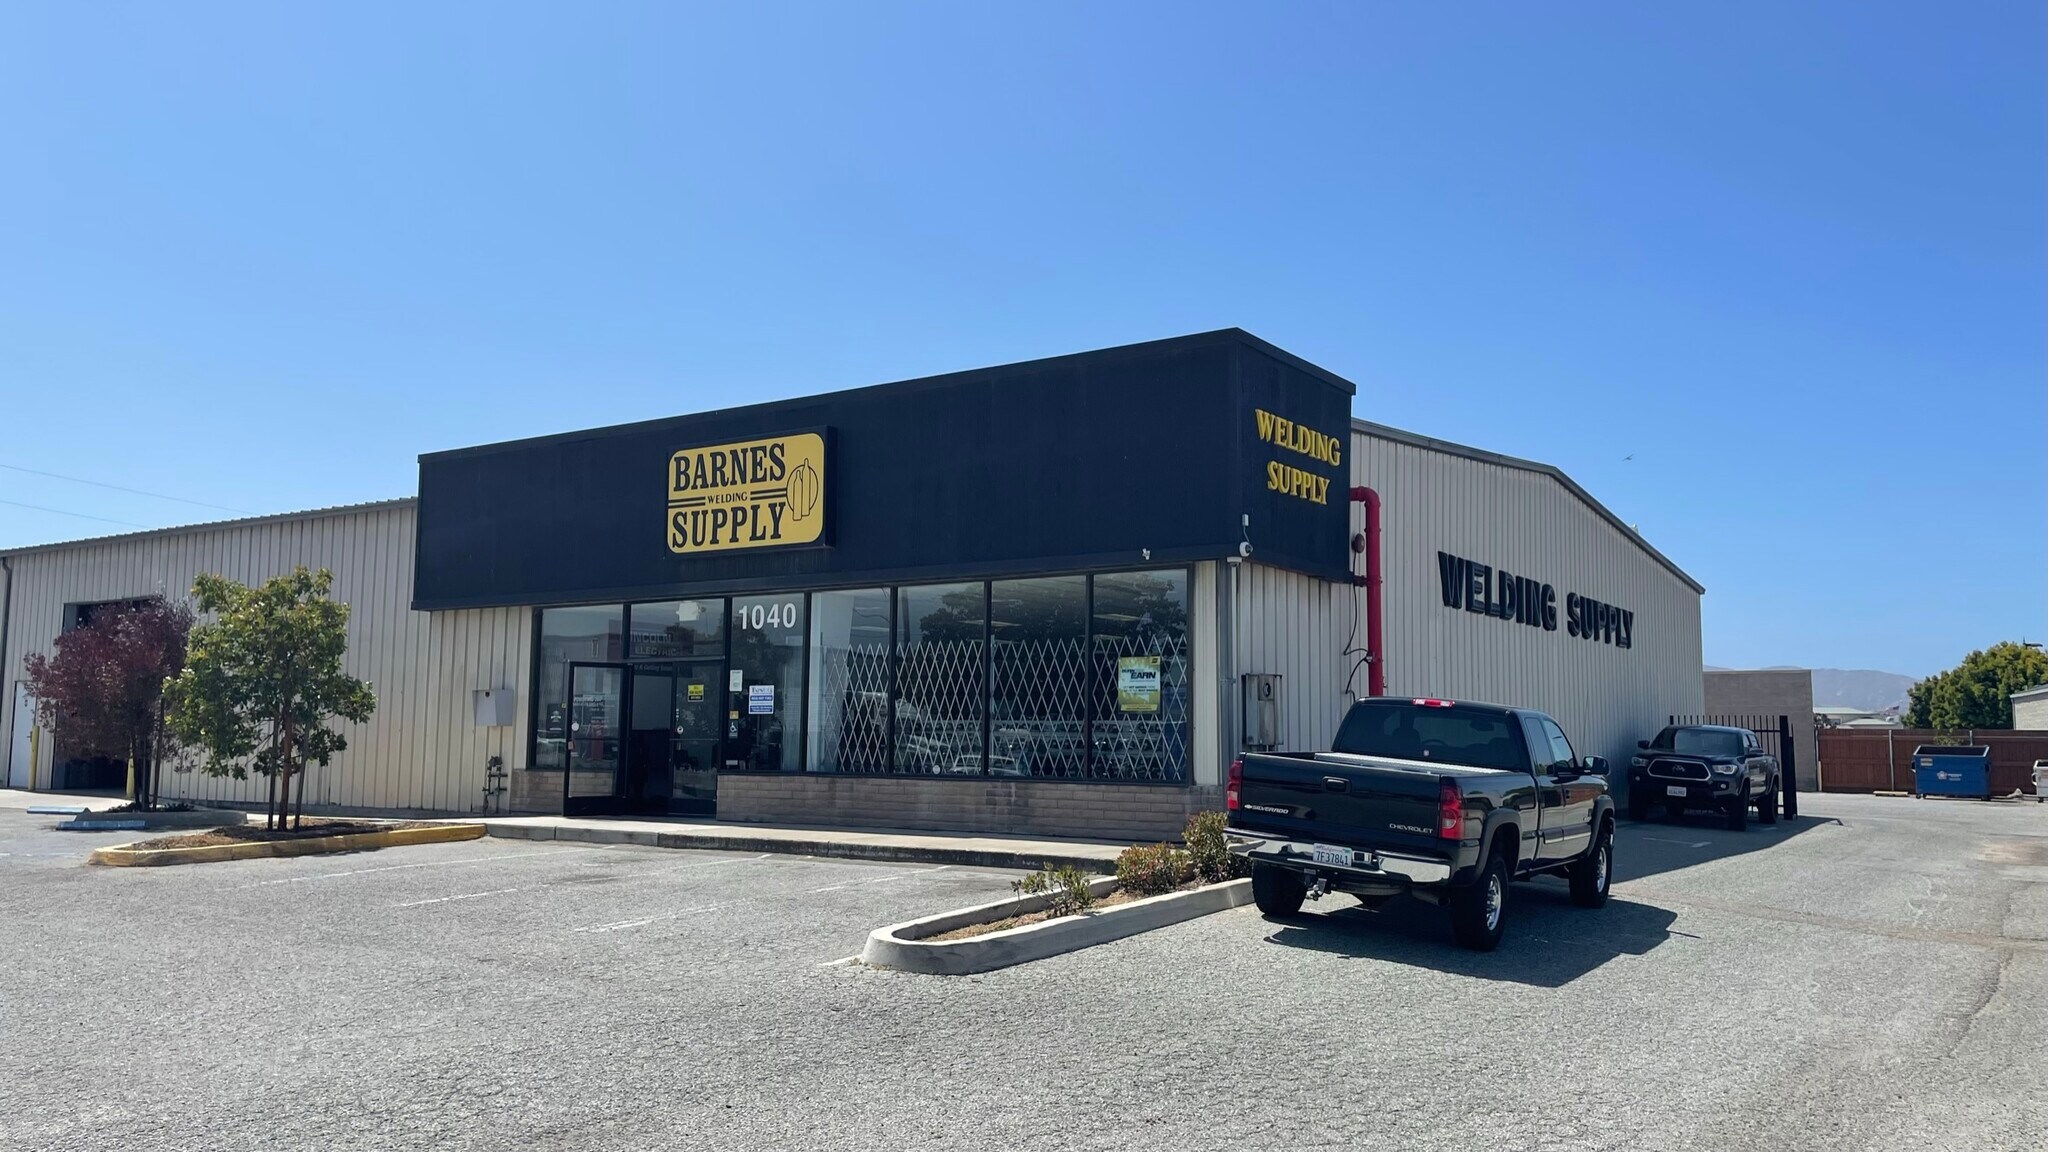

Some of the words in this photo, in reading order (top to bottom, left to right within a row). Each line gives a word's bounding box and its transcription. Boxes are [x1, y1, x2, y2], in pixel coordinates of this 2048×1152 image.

[1255, 408, 1341, 467] WELDING
[673, 443, 786, 492] BARNES
[1267, 460, 1330, 505] SUPPLY
[707, 491, 748, 504] WELDING
[672, 502, 786, 548] SUPPLY
[1437, 550, 1557, 631] WELDING
[1566, 592, 1634, 649] SUPPLY
[738, 602, 797, 630] 1040
[630, 631, 672, 645] INCOLN
[1131, 671, 1156, 680] EARN
[1252, 804, 1289, 815] SILVERADO
[1389, 823, 1433, 834] CHEVROLET
[1315, 850, 1349, 866] 7F37841
